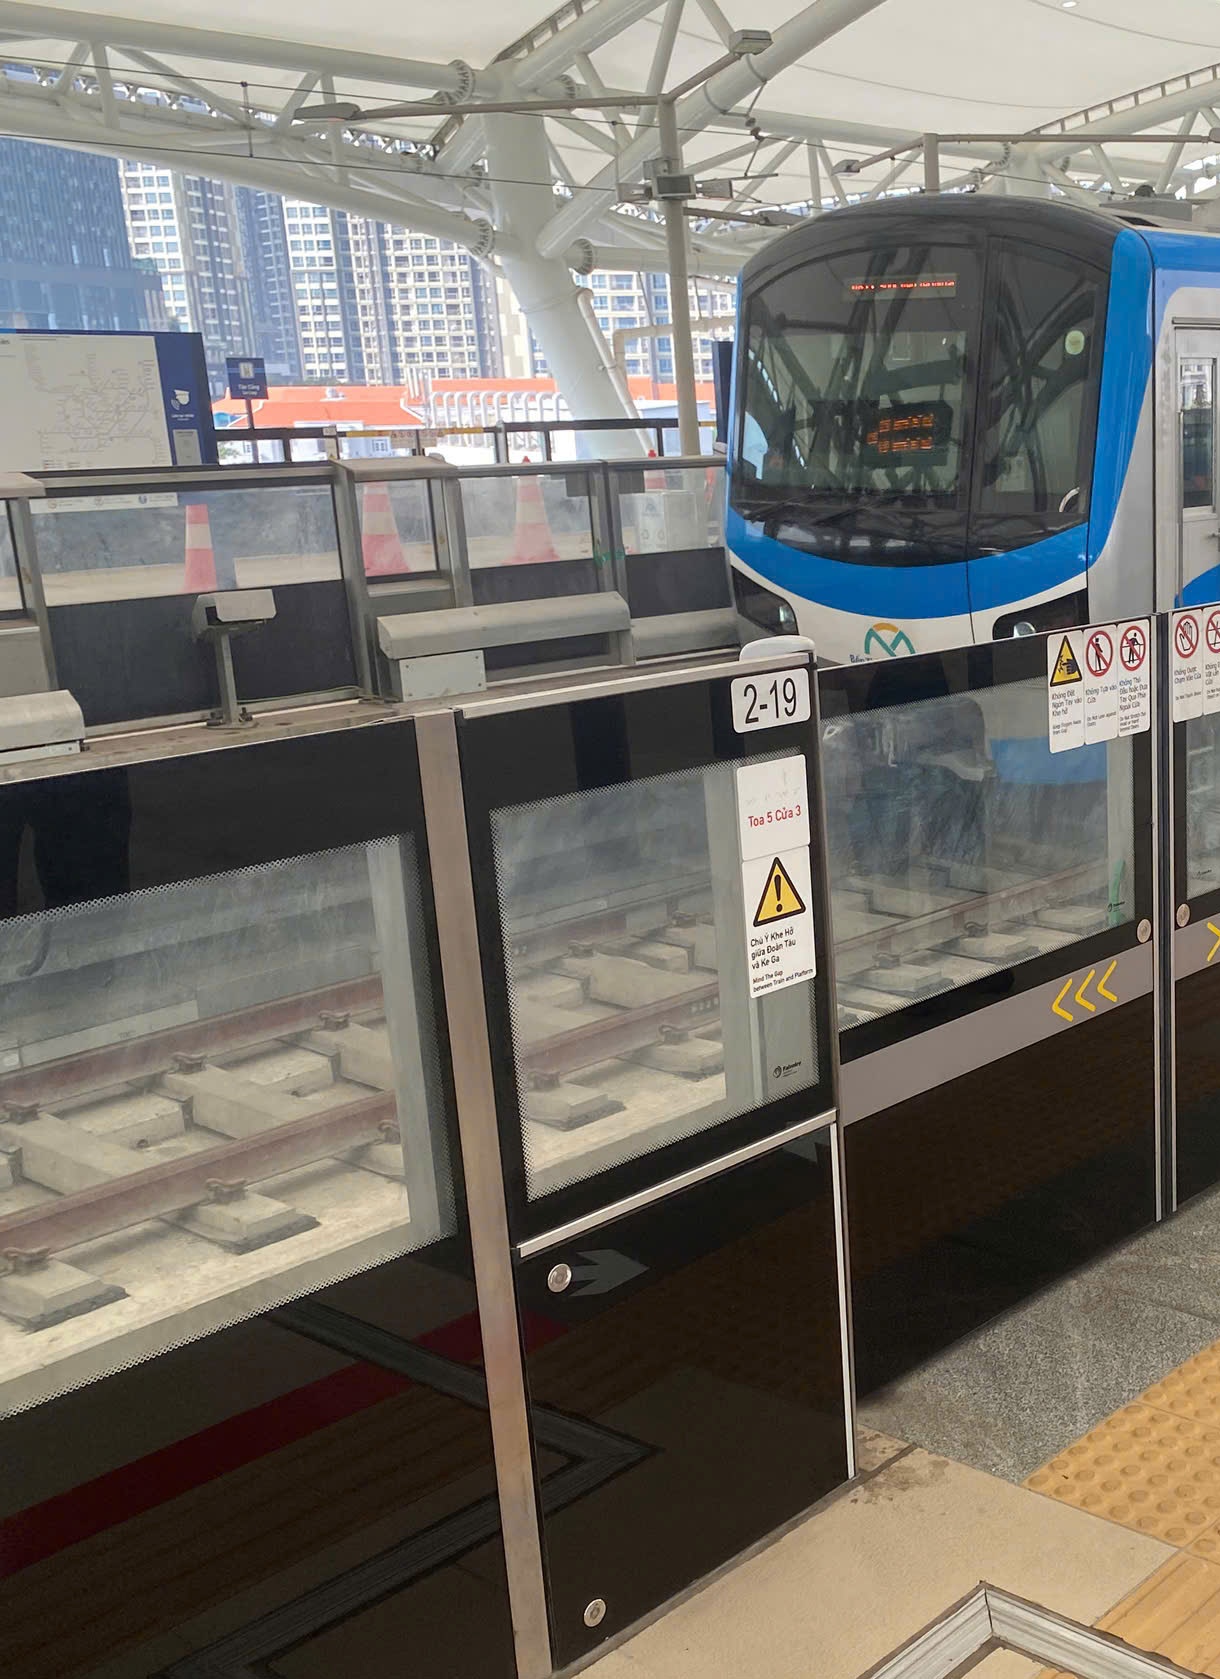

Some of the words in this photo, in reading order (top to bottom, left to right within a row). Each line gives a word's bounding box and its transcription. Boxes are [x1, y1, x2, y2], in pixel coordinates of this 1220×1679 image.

[744, 677, 797, 724] 2-19
[748, 816, 764, 828] Toa
[767, 811, 773, 823] 5
[775, 807, 793, 821] Cửa
[796, 804, 801, 816] 3
[750, 937, 763, 947] Chú
[770, 932, 784, 941] Khe
[766, 943, 783, 954] Đoàn
[784, 939, 796, 947] Tàu
[752, 961, 759, 970] và
[761, 958, 770, 967] Ke
[771, 955, 780, 963] Ga
